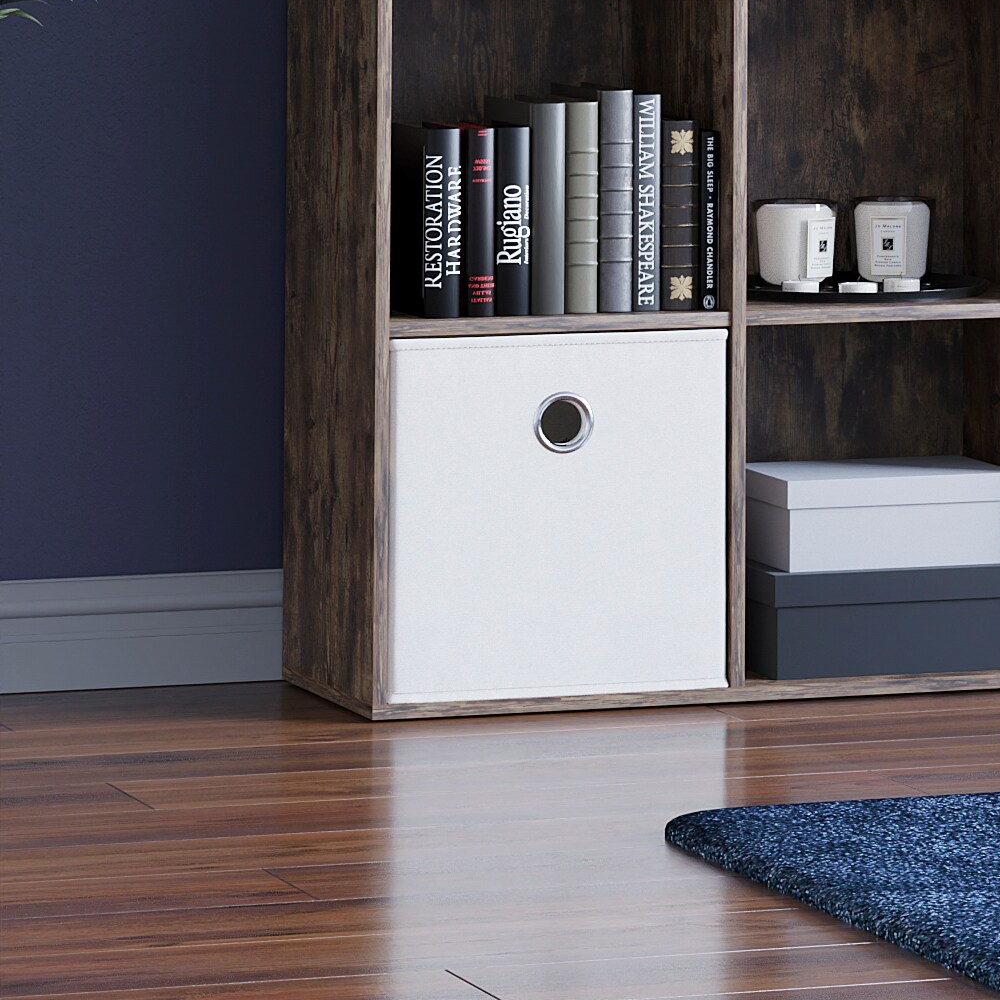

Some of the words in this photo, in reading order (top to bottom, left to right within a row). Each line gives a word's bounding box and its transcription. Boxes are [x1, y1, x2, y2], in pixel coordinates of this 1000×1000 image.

[638, 98, 655, 180] WILLIAM
[706, 136, 714, 151] THE
[706, 153, 714, 168] BIG
[706, 170, 714, 193] SLEEP
[424, 154, 443, 289] RESTORATION
[446, 165, 462, 276] HARDWARE
[496, 184, 530, 265] Rugiano
[638, 184, 655, 306] SHAKESPEARE
[706, 202, 714, 244] RAYMOND
[706, 246, 714, 289] CHANDLER
